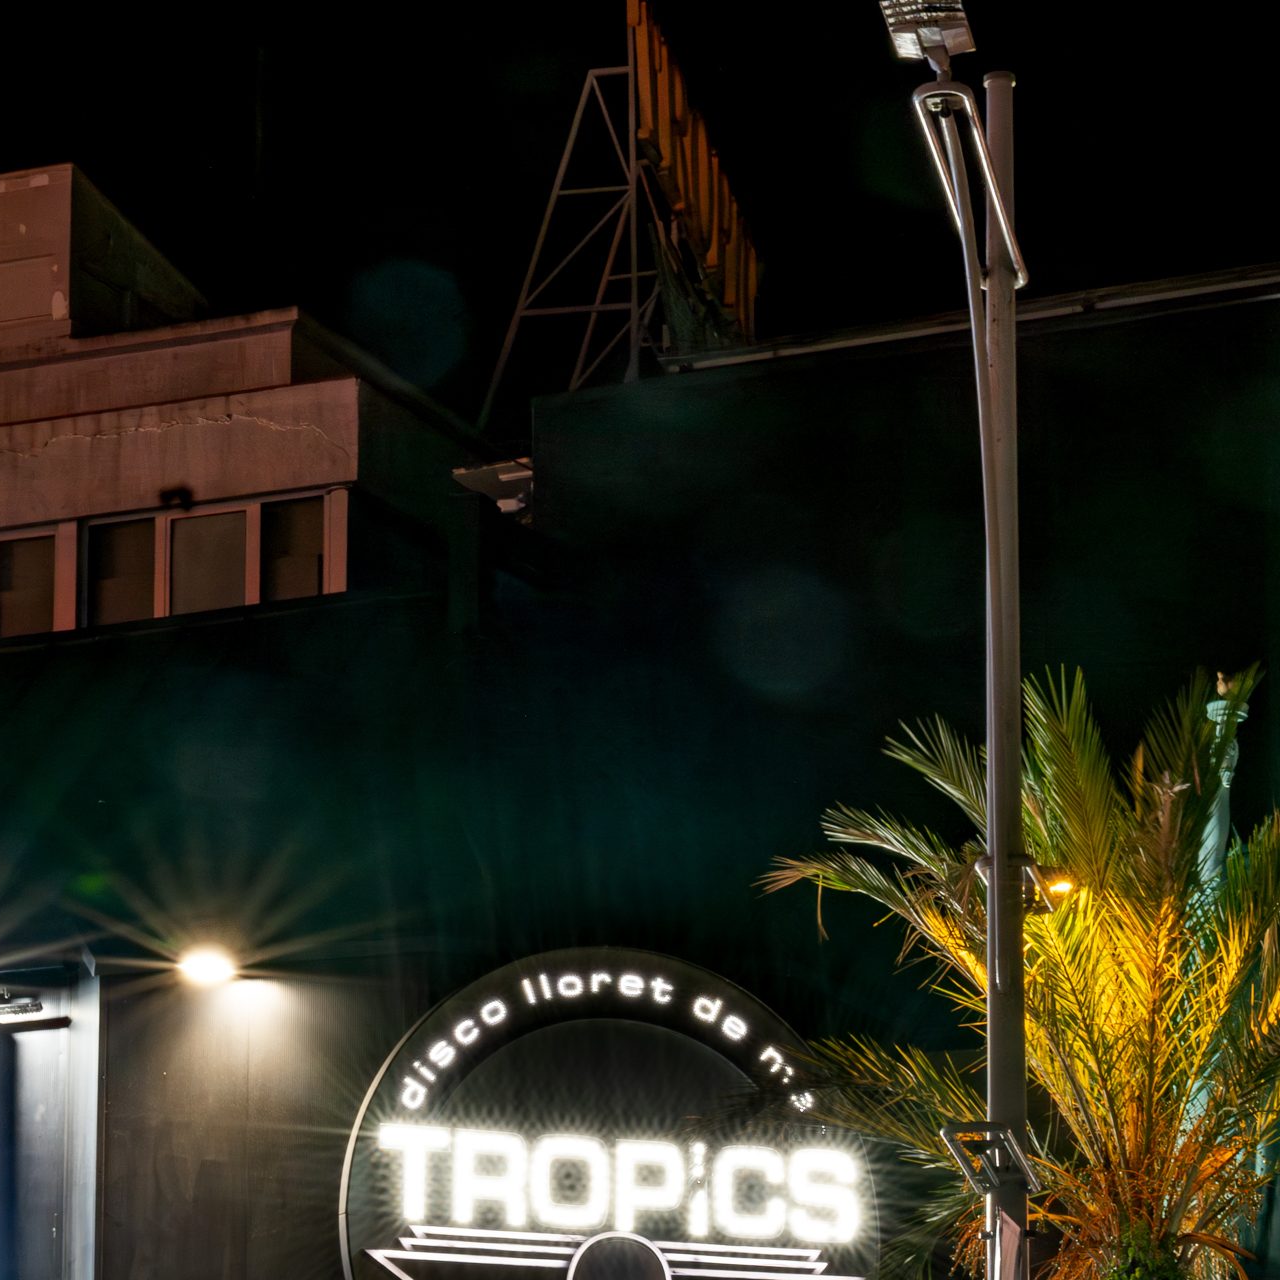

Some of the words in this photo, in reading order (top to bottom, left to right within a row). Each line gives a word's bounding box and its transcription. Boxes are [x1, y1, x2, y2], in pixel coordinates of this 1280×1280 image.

[401, 998, 508, 1111] disco
[521, 972, 673, 1005] lloret
[692, 995, 748, 1043] de
